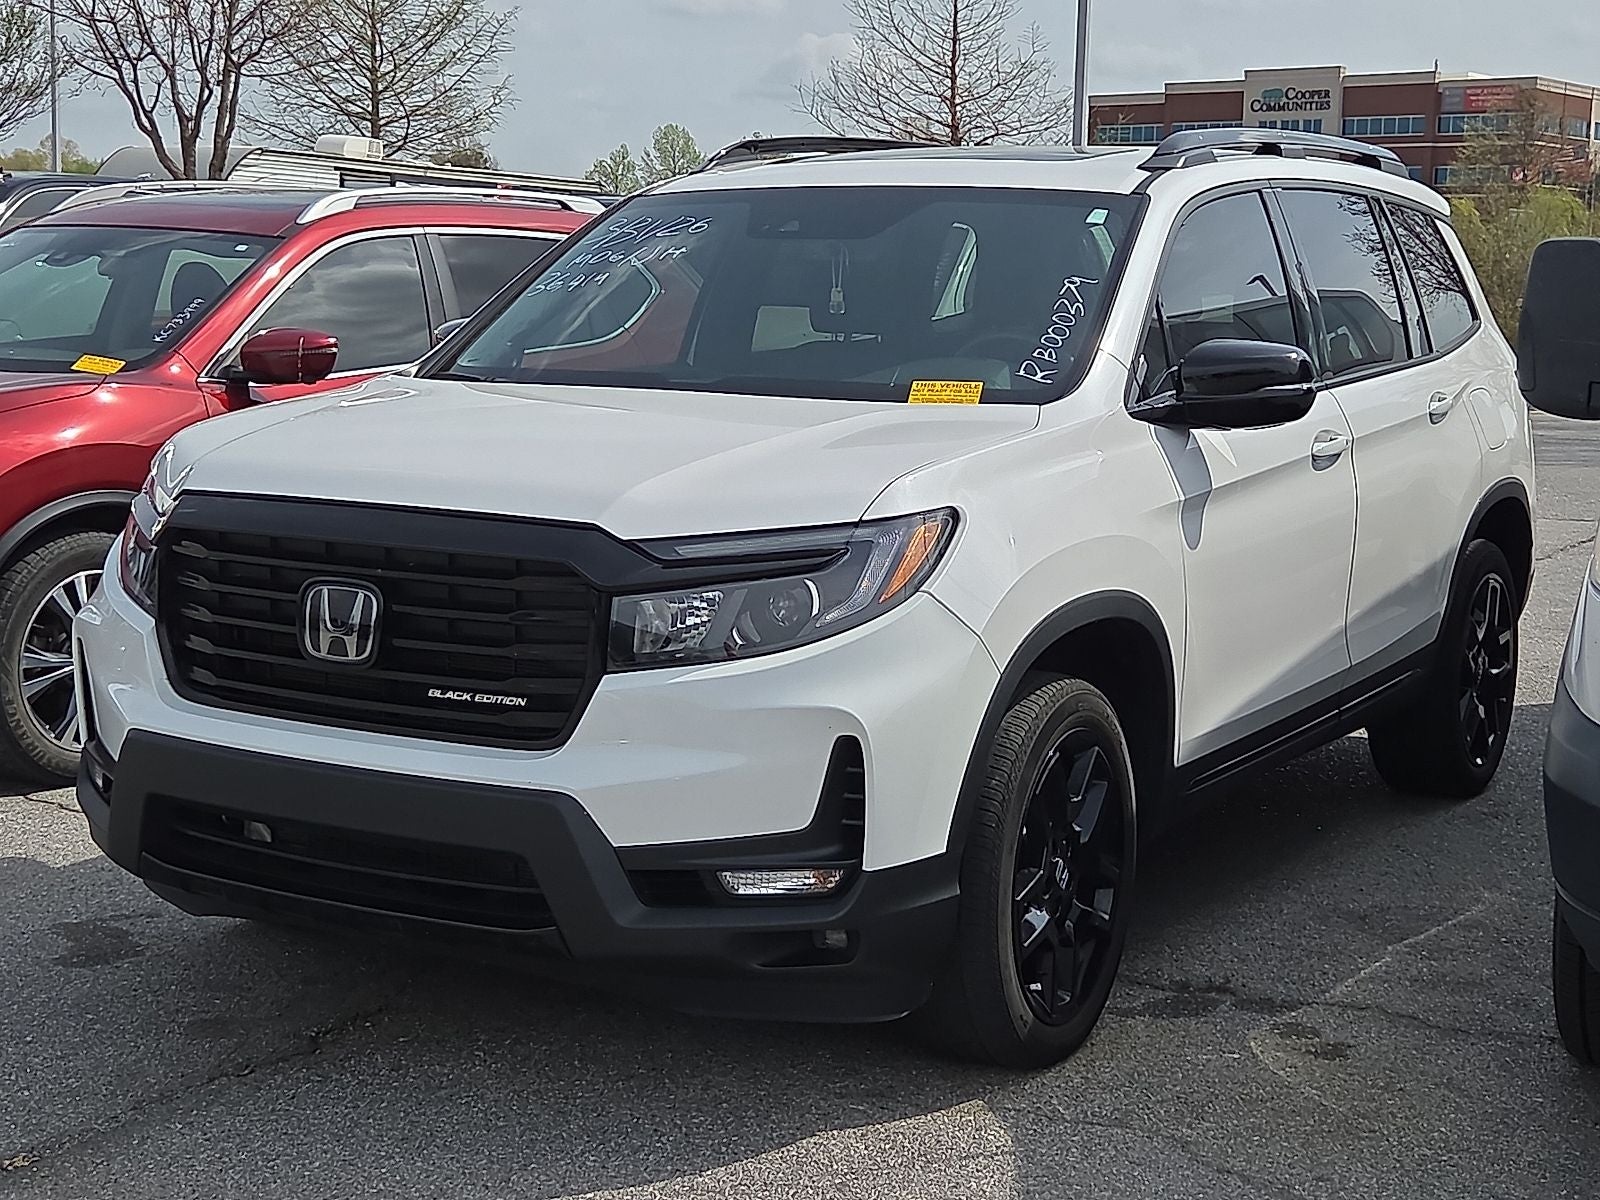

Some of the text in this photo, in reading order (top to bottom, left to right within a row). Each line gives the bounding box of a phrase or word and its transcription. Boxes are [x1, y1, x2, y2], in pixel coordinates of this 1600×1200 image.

[1285, 87, 1331, 100] COOPER
[1250, 99, 1331, 112] COMMUNITIES
[428, 688, 528, 706] BLACK EDITION
